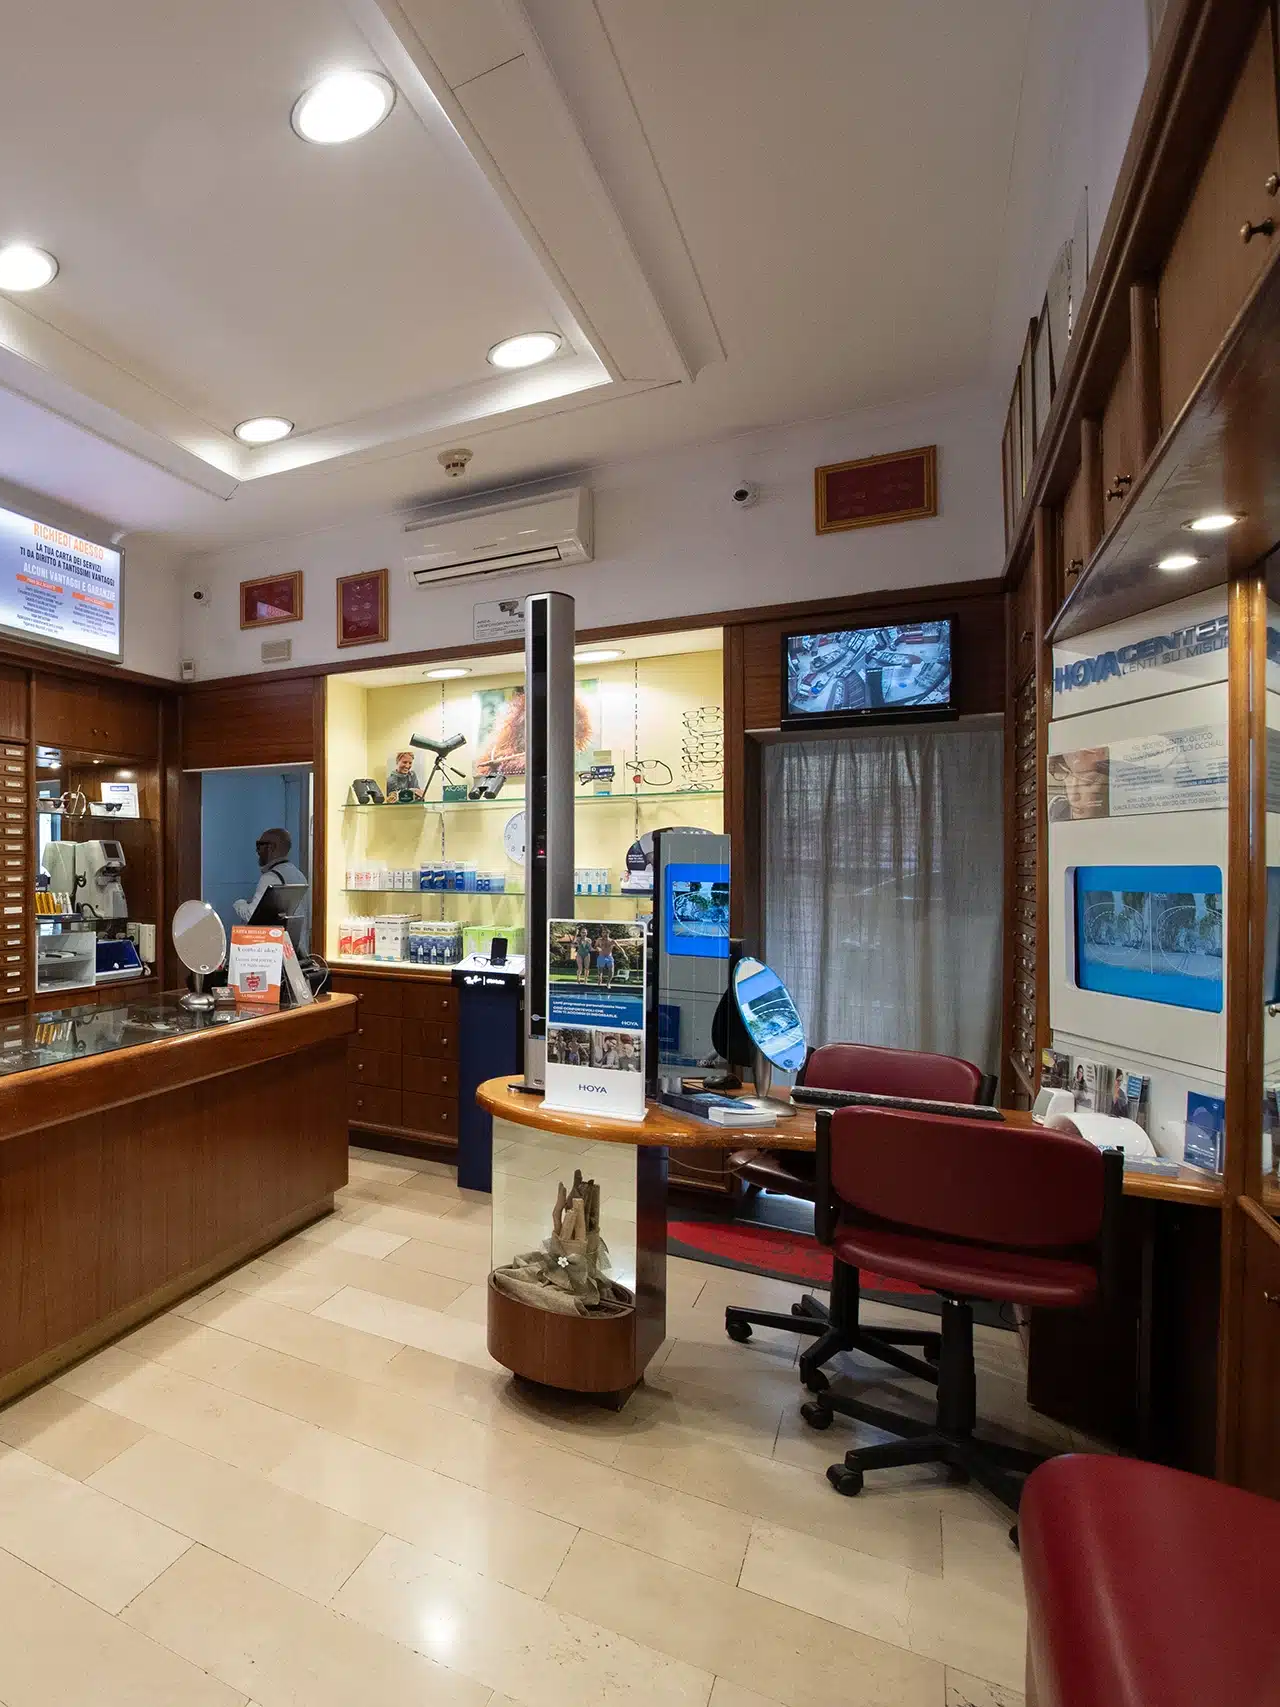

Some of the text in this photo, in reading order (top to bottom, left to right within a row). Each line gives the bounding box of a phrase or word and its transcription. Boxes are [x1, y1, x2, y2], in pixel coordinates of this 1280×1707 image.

[33, 523, 104, 560] RICHIEDI ADESSO
[36, 542, 102, 573] LA TUA CARTA DEI SERVIZI
[20, 546, 25, 555] TI
[36, 552, 56, 567] DIRITTO
[62, 561, 91, 578] TANTISSIMI
[92, 573, 115, 587] VANTAGGI
[23, 562, 48, 579] ALCUNI
[49, 570, 81, 590] VANTAGGI
[82, 583, 86, 591] E
[87, 584, 116, 600] GARANZIE
[1121, 658, 1157, 675] LENTI
[1162, 651, 1182, 665] SU
[578, 1084, 608, 1094] HOYA
